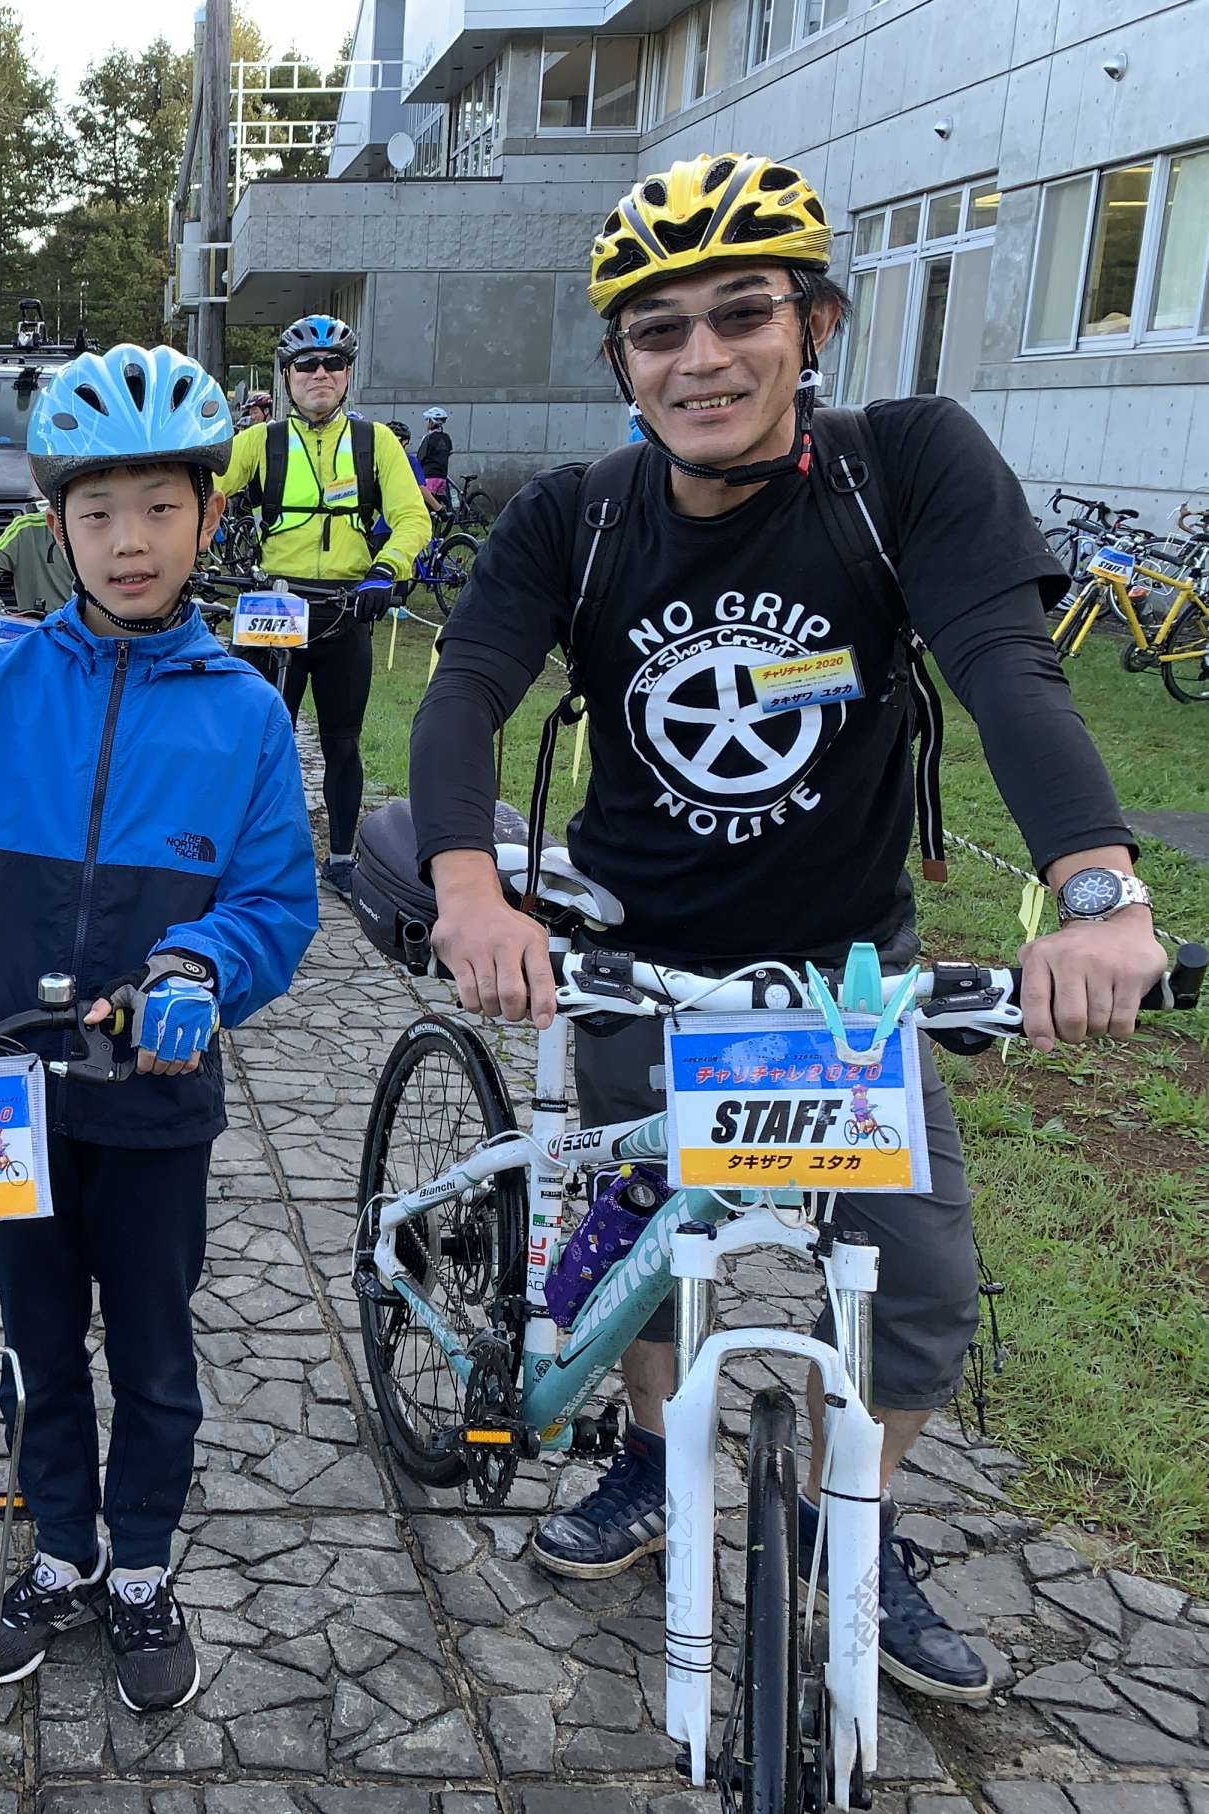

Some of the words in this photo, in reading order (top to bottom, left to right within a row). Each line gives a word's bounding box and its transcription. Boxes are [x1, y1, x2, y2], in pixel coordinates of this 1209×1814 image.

[248, 618, 288, 632] STAFF
[628, 600, 693, 655] NO
[715, 591, 831, 643] GRIP
[634, 667, 663, 696] RC
[657, 638, 713, 668] Shop
[717, 627, 796, 658] Circuit
[815, 656, 844, 670] 2020
[654, 792, 718, 835] NO
[727, 781, 821, 844] LIFE
[166, 837, 200, 851] NORTH
[183, 832, 202, 843] THE
[175, 849, 199, 860] FACE
[710, 1100, 844, 1144] STAFF
[728, 1154, 793, 1169] タキザワ
[809, 1155, 862, 1170] ユタカ
[419, 1179, 456, 1198] Bianchi
